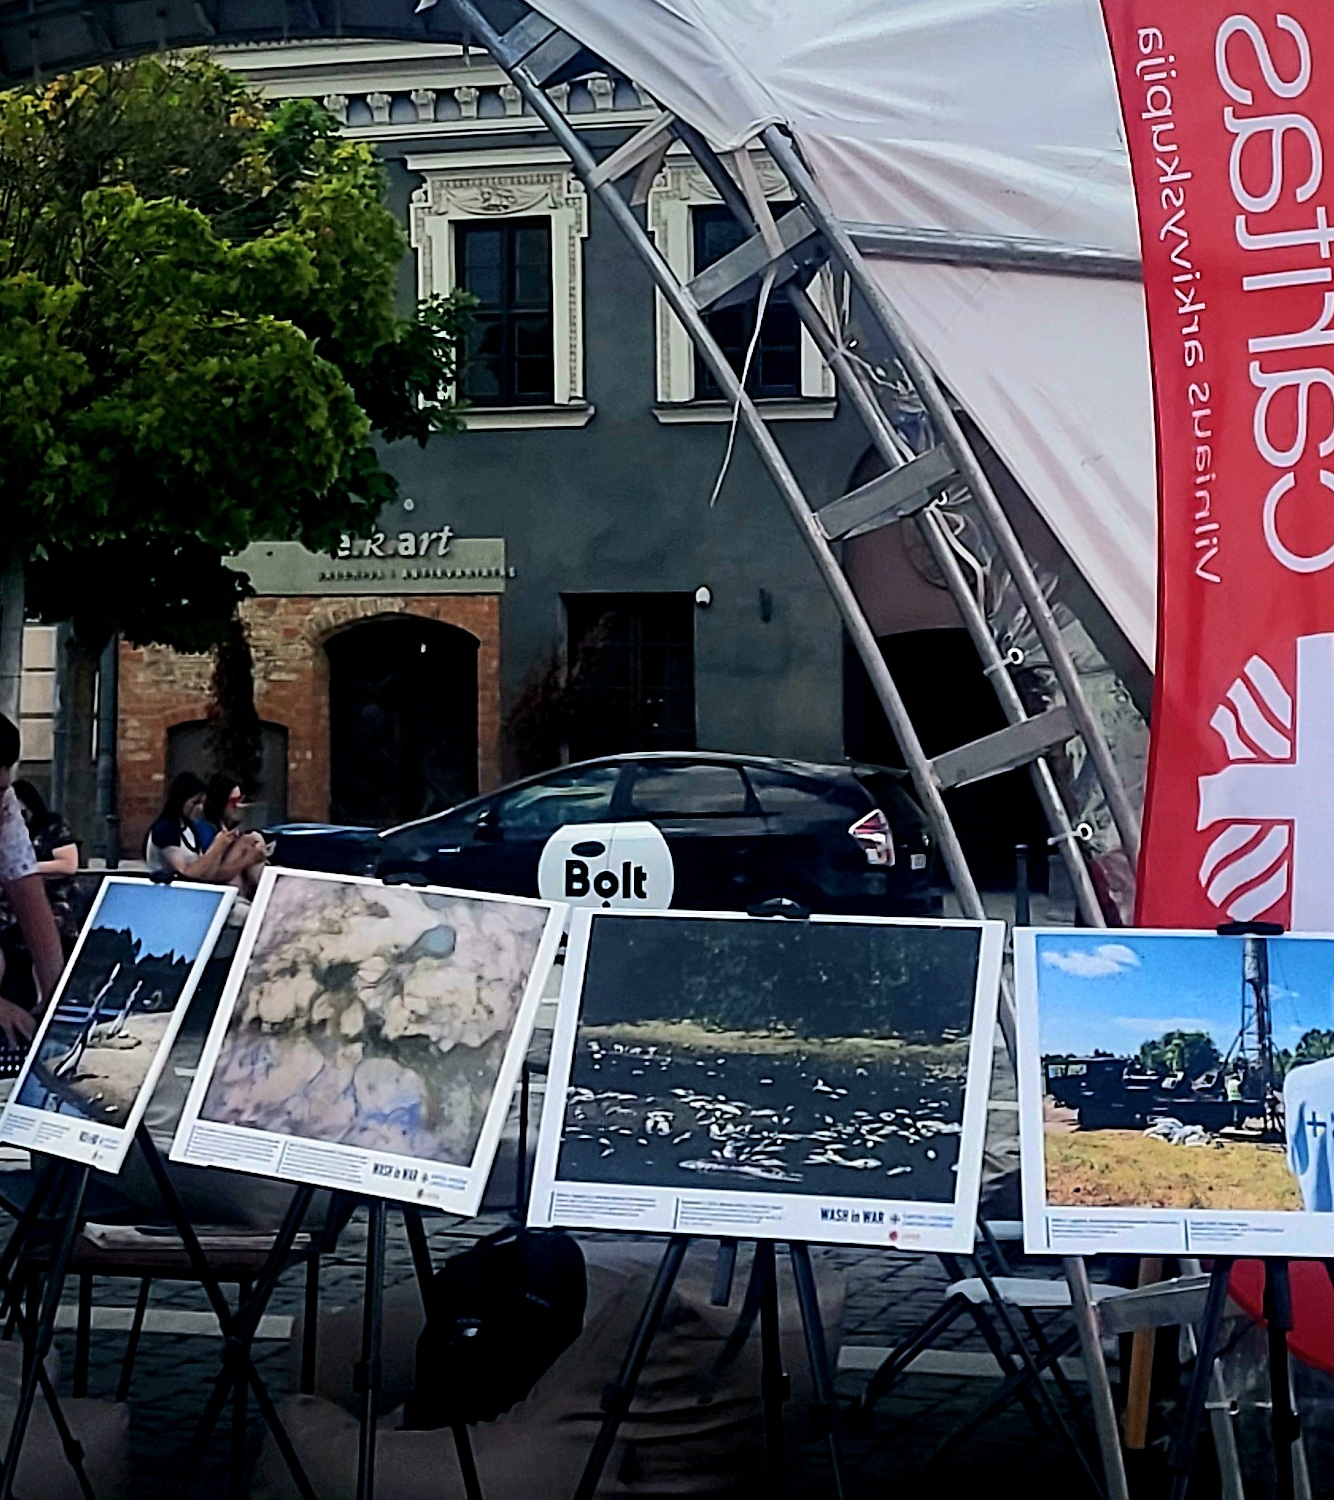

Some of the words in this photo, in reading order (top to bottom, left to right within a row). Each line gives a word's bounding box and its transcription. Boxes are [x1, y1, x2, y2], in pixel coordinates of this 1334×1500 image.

[565, 858, 648, 900] Bolt
[820, 1207, 849, 1222] WASH
[851, 1209, 860, 1223] in
[862, 1210, 885, 1225] WAR
